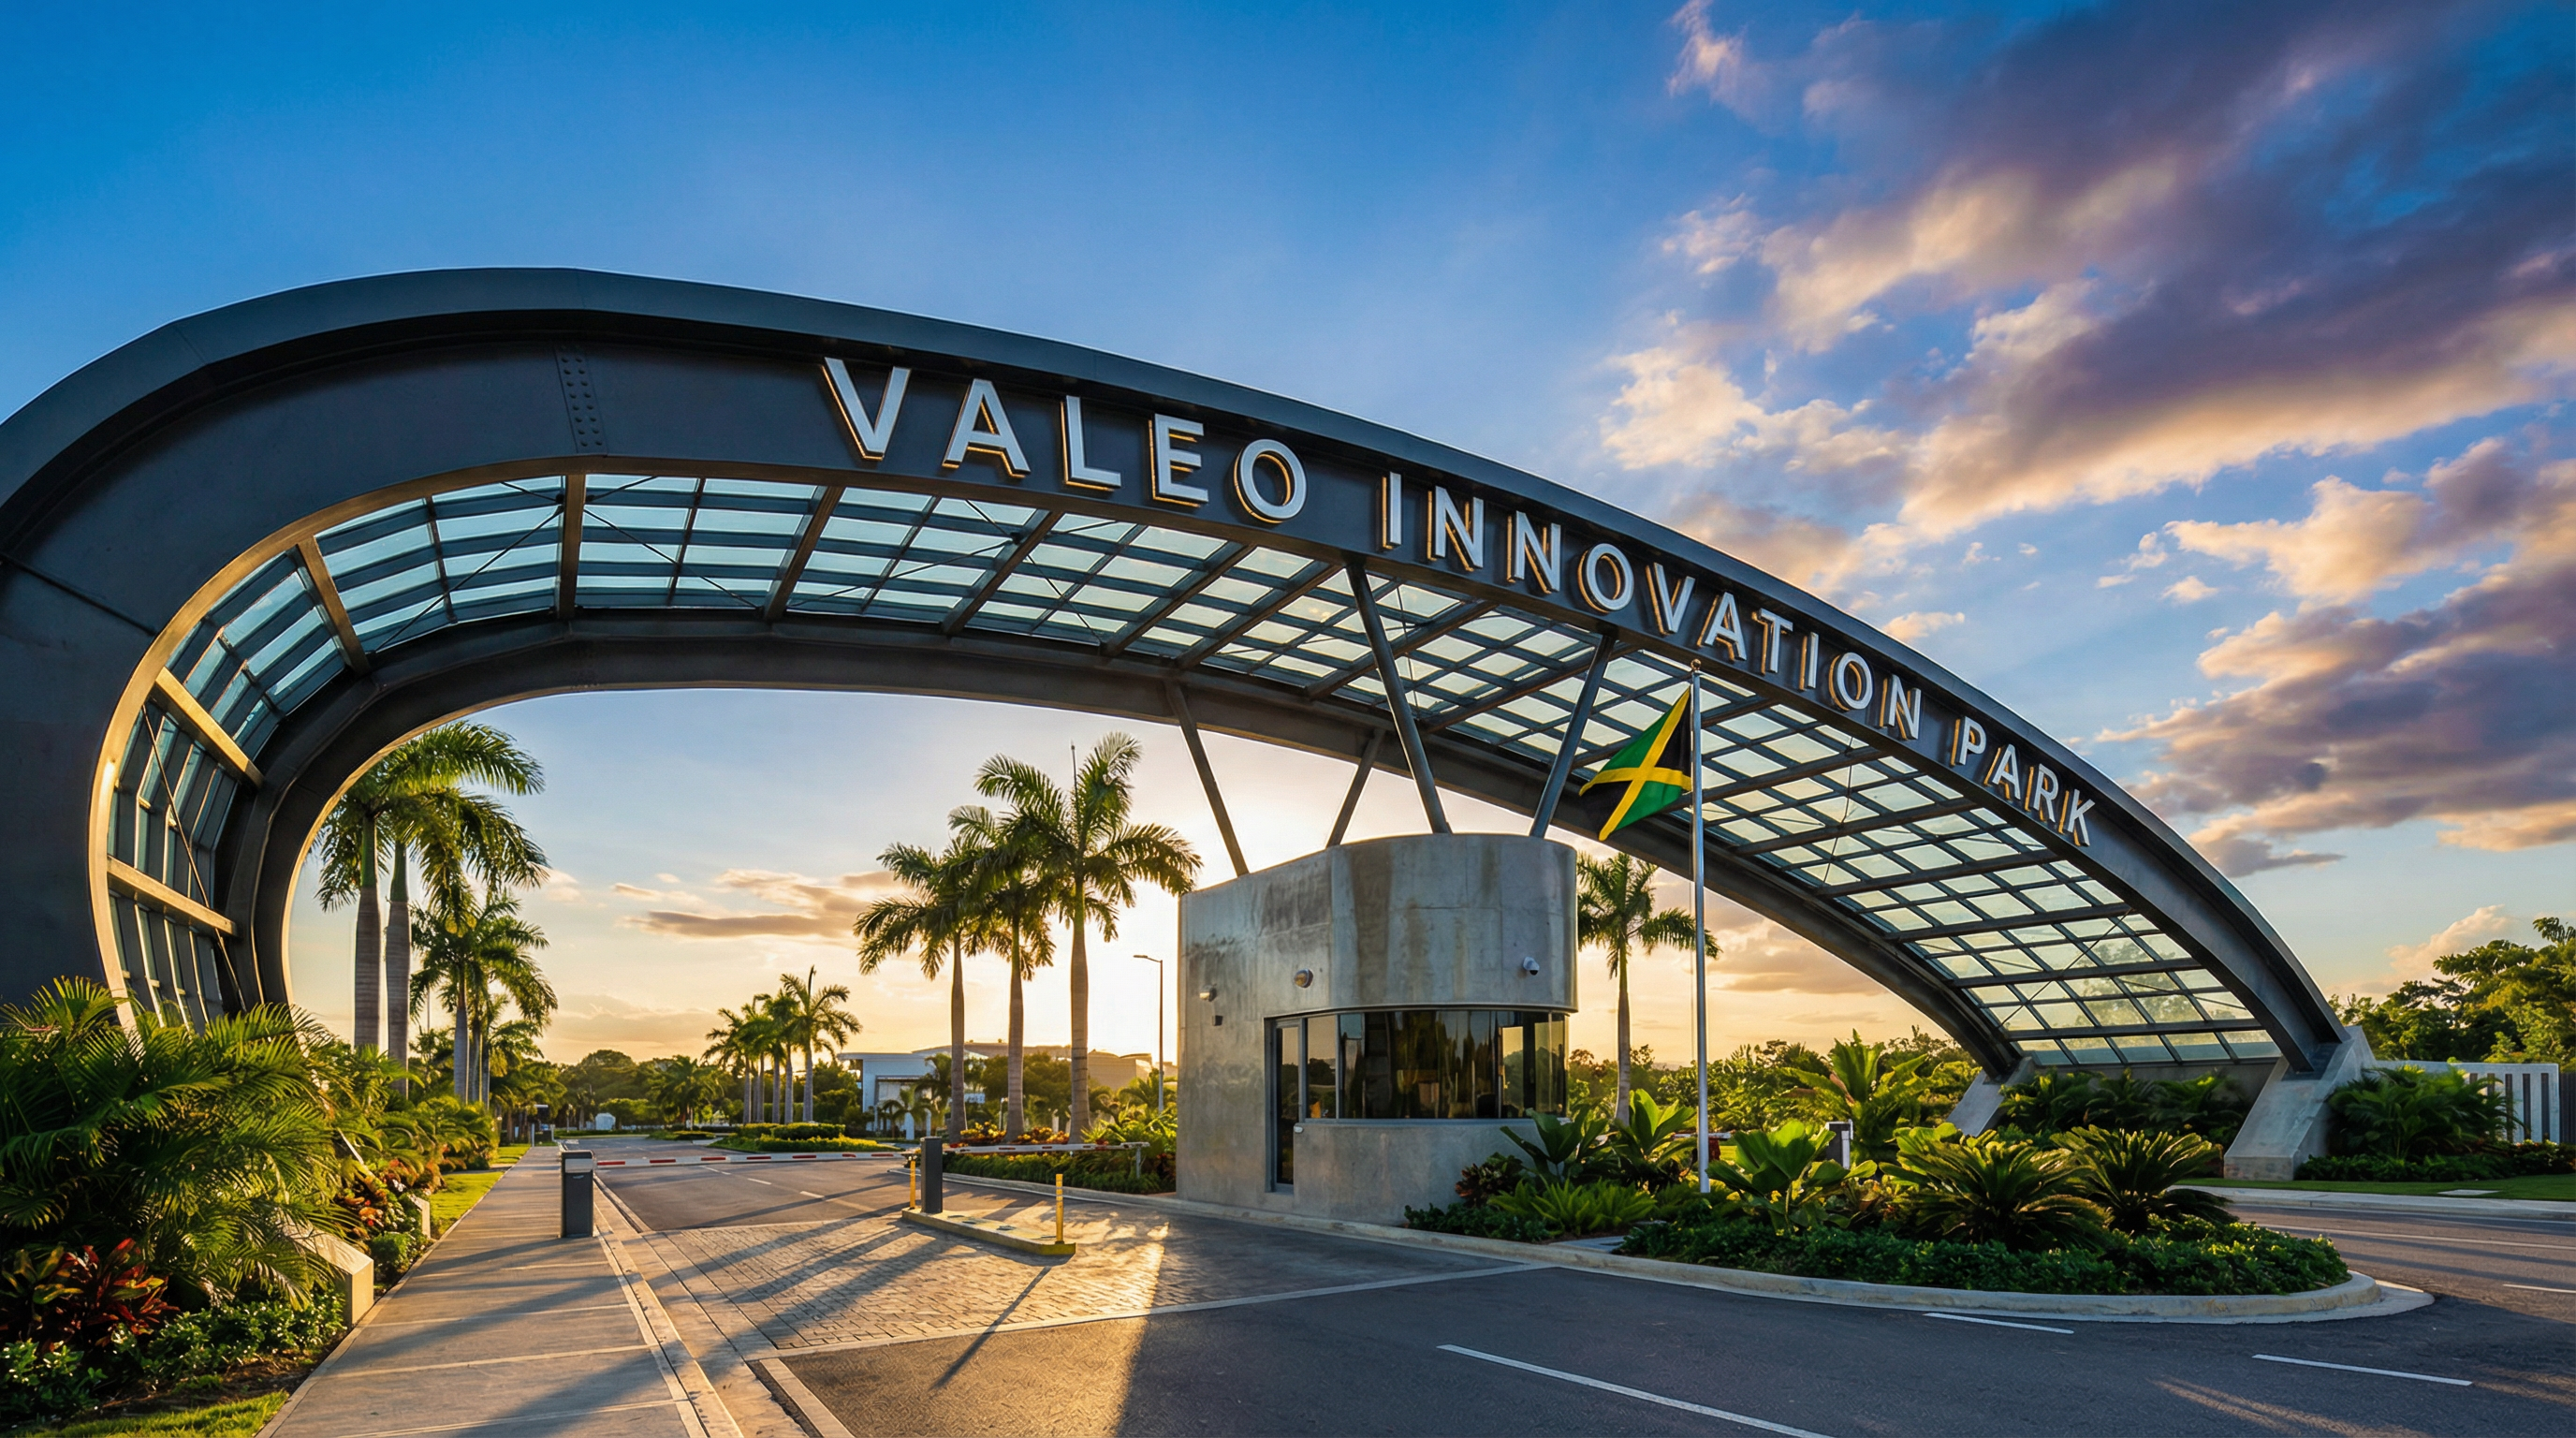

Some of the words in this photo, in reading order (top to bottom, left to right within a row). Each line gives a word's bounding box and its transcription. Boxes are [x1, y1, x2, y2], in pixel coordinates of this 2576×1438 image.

[822, 358, 1307, 522] VALEO
[1381, 472, 1922, 740] INNOVATION
[1951, 717, 2095, 846] PARK
